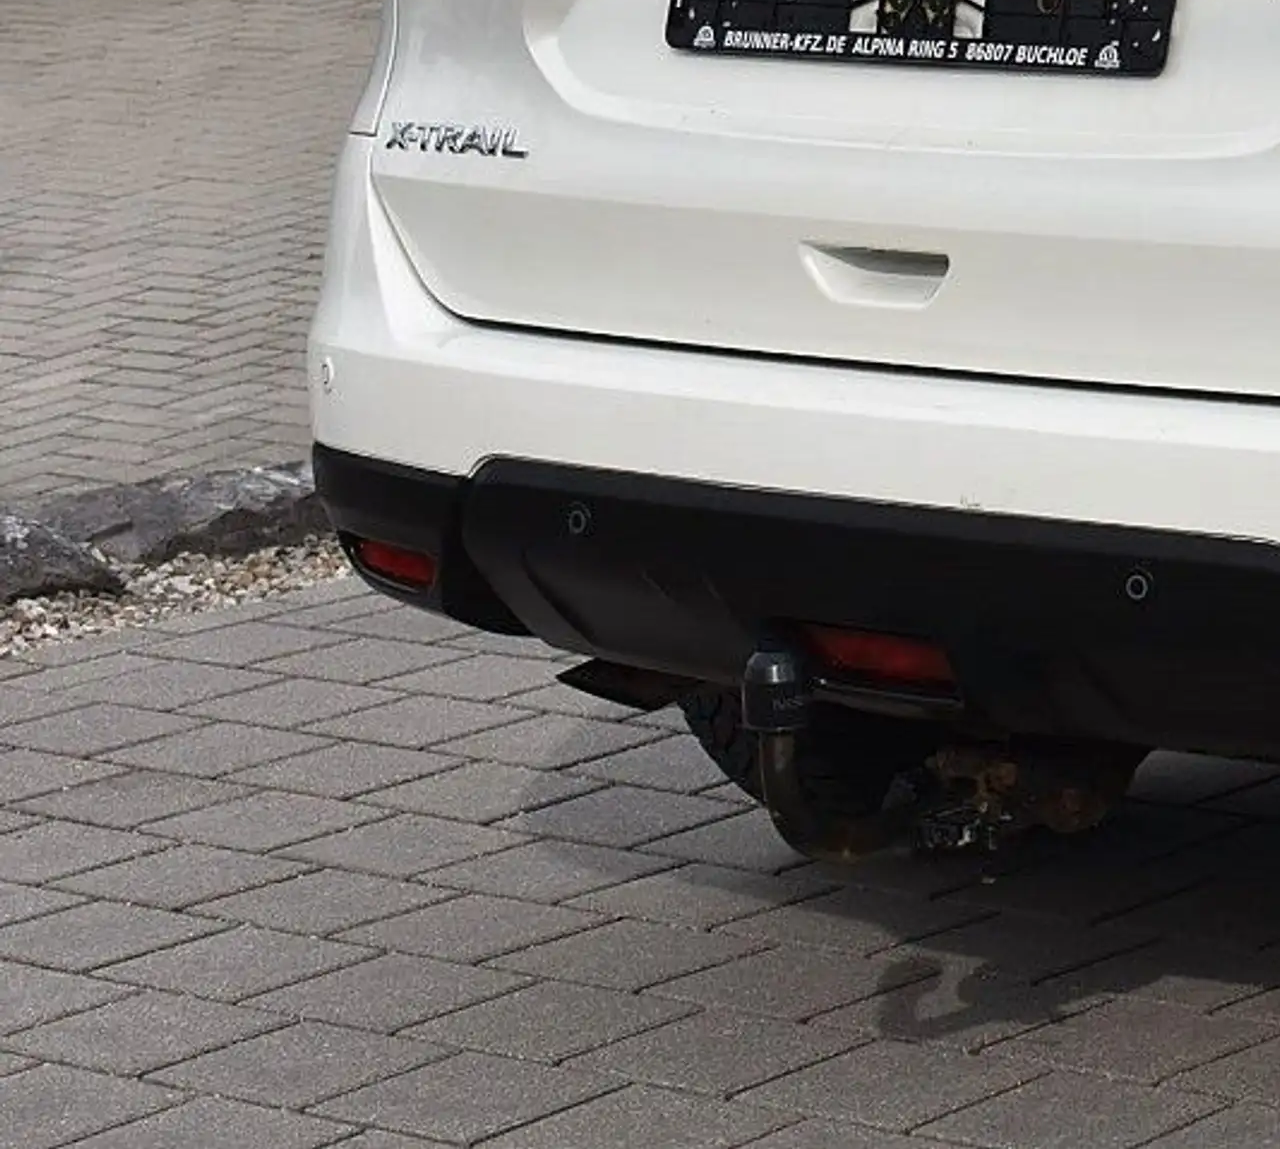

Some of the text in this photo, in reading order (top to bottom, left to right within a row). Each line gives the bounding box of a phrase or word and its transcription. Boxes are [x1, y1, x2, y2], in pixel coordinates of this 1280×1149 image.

[851, 36, 904, 57] ALPINA
[907, 39, 946, 58] RING
[949, 41, 959, 59] 5
[964, 42, 1014, 62] 86807
[1015, 45, 1089, 66] BUCHLOE
[386, 122, 529, 159] X-TRAIL
